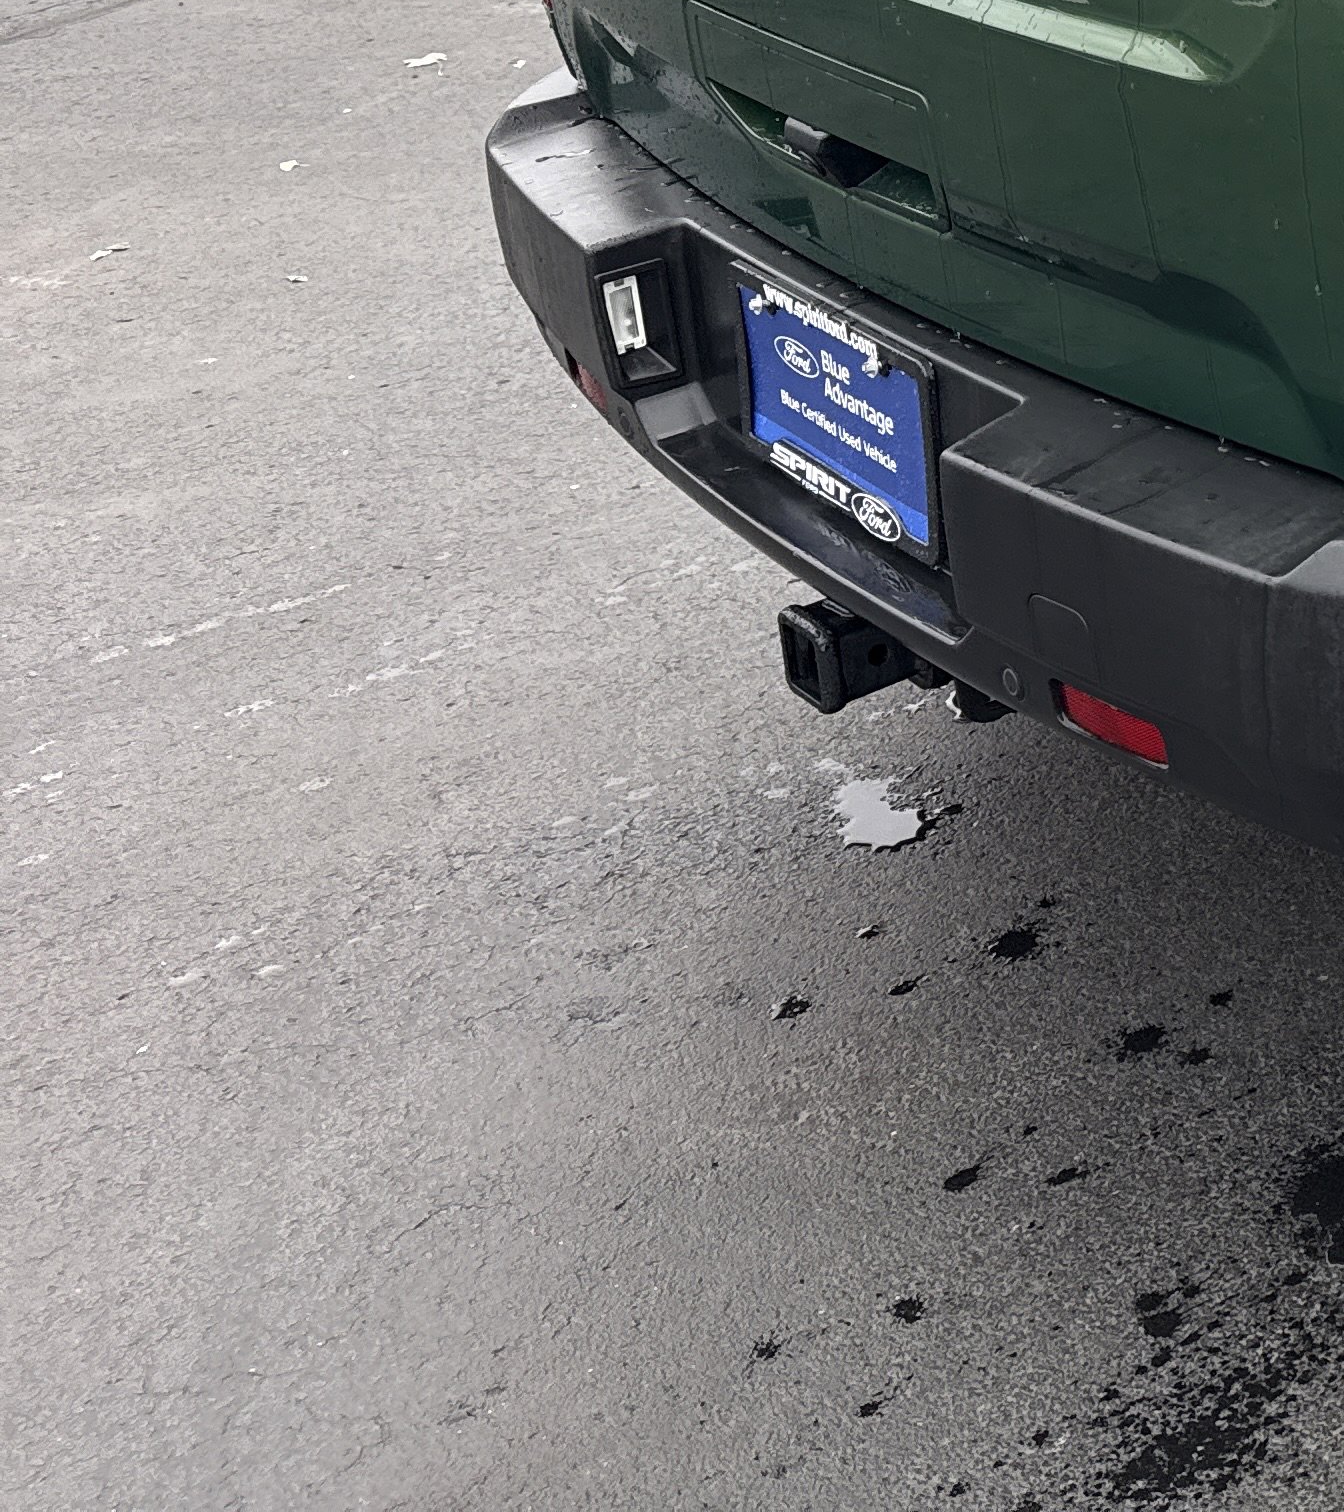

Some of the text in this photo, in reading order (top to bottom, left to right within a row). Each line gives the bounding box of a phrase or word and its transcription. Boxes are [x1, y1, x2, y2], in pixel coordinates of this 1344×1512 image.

[762, 283, 878, 361] www.spiritford.com
[781, 339, 814, 375] Ford
[820, 349, 850, 385] Blue
[780, 388, 897, 474] Blue Certified Used Vehicle
[824, 377, 894, 436] Advantage
[769, 442, 894, 538] SPIRIT Ford
